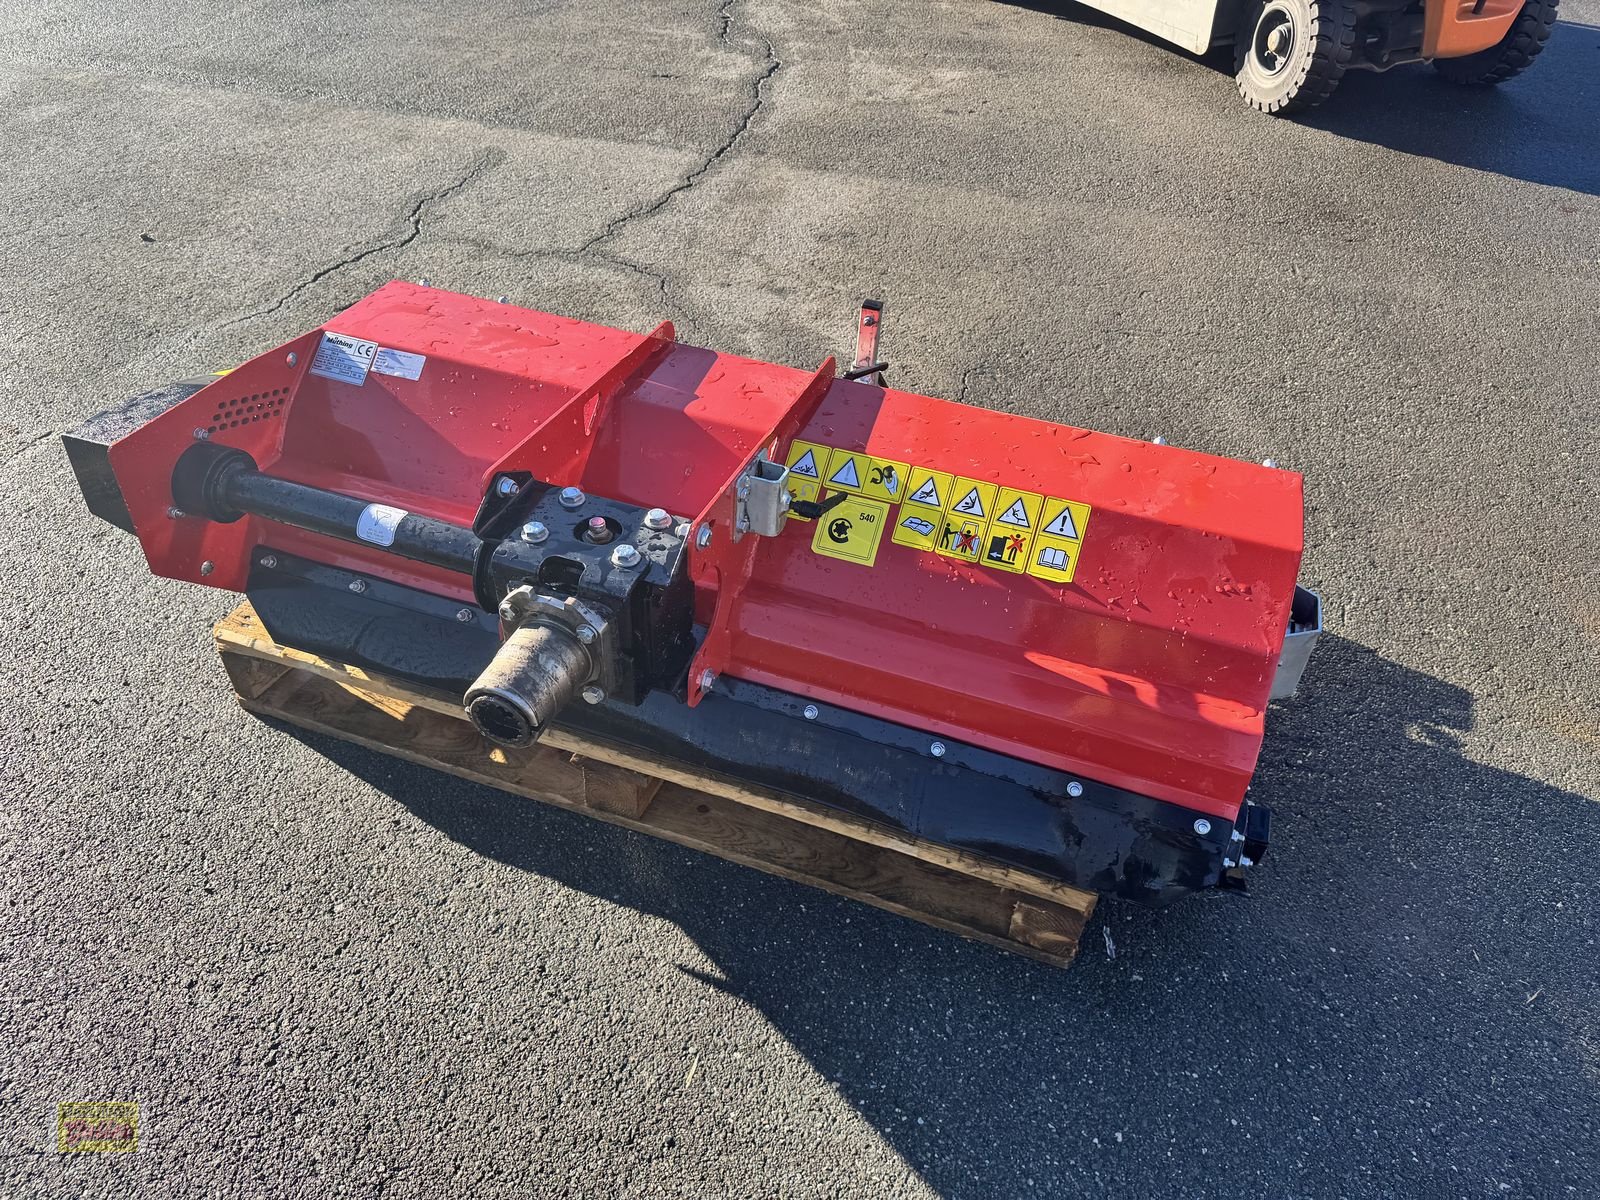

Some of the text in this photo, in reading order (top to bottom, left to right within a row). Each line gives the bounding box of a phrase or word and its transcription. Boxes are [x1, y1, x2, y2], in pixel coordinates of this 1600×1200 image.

[326, 336, 354, 349] Müthing
[357, 344, 374, 357] CE
[859, 512, 876, 523] 540
